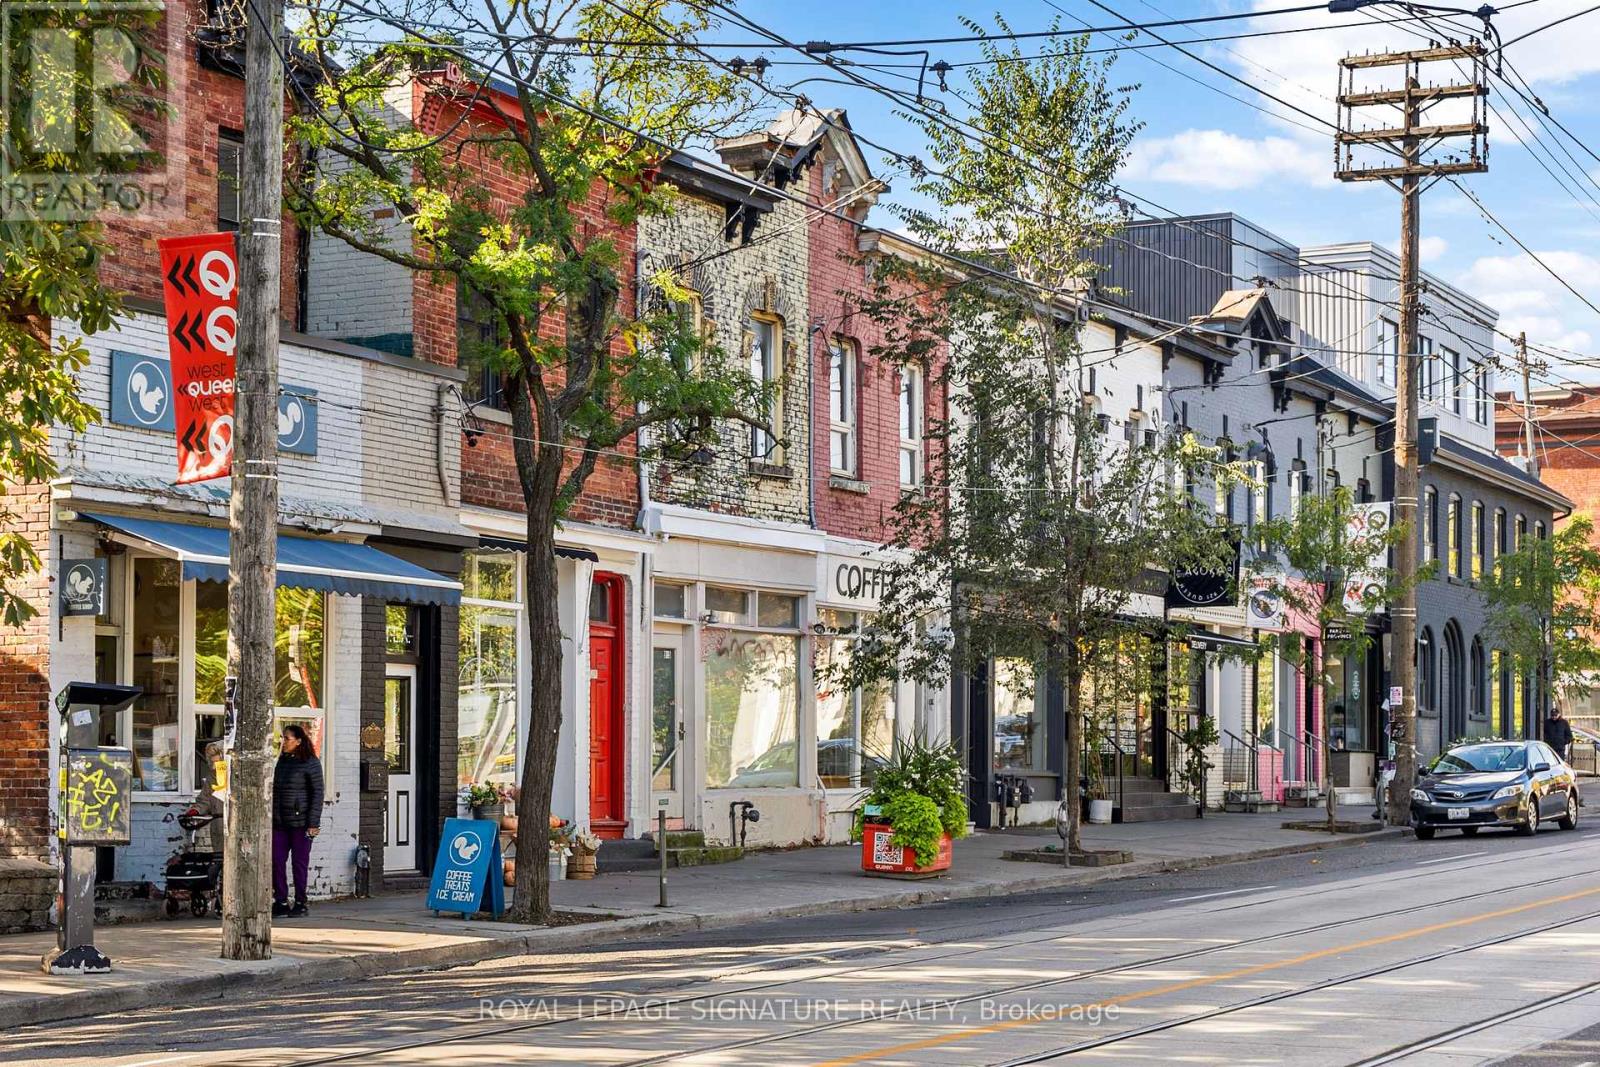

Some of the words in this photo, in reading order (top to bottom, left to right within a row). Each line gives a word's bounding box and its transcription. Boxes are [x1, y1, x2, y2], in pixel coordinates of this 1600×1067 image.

[199, 250, 236, 300] Q
[206, 306, 237, 356] Q
[187, 363, 227, 379] west
[189, 396, 227, 412] west
[446, 869, 473, 882] COFFEE
[445, 880, 471, 892] TREATS
[436, 888, 450, 900] ICE
[451, 890, 475, 902] CREAM
